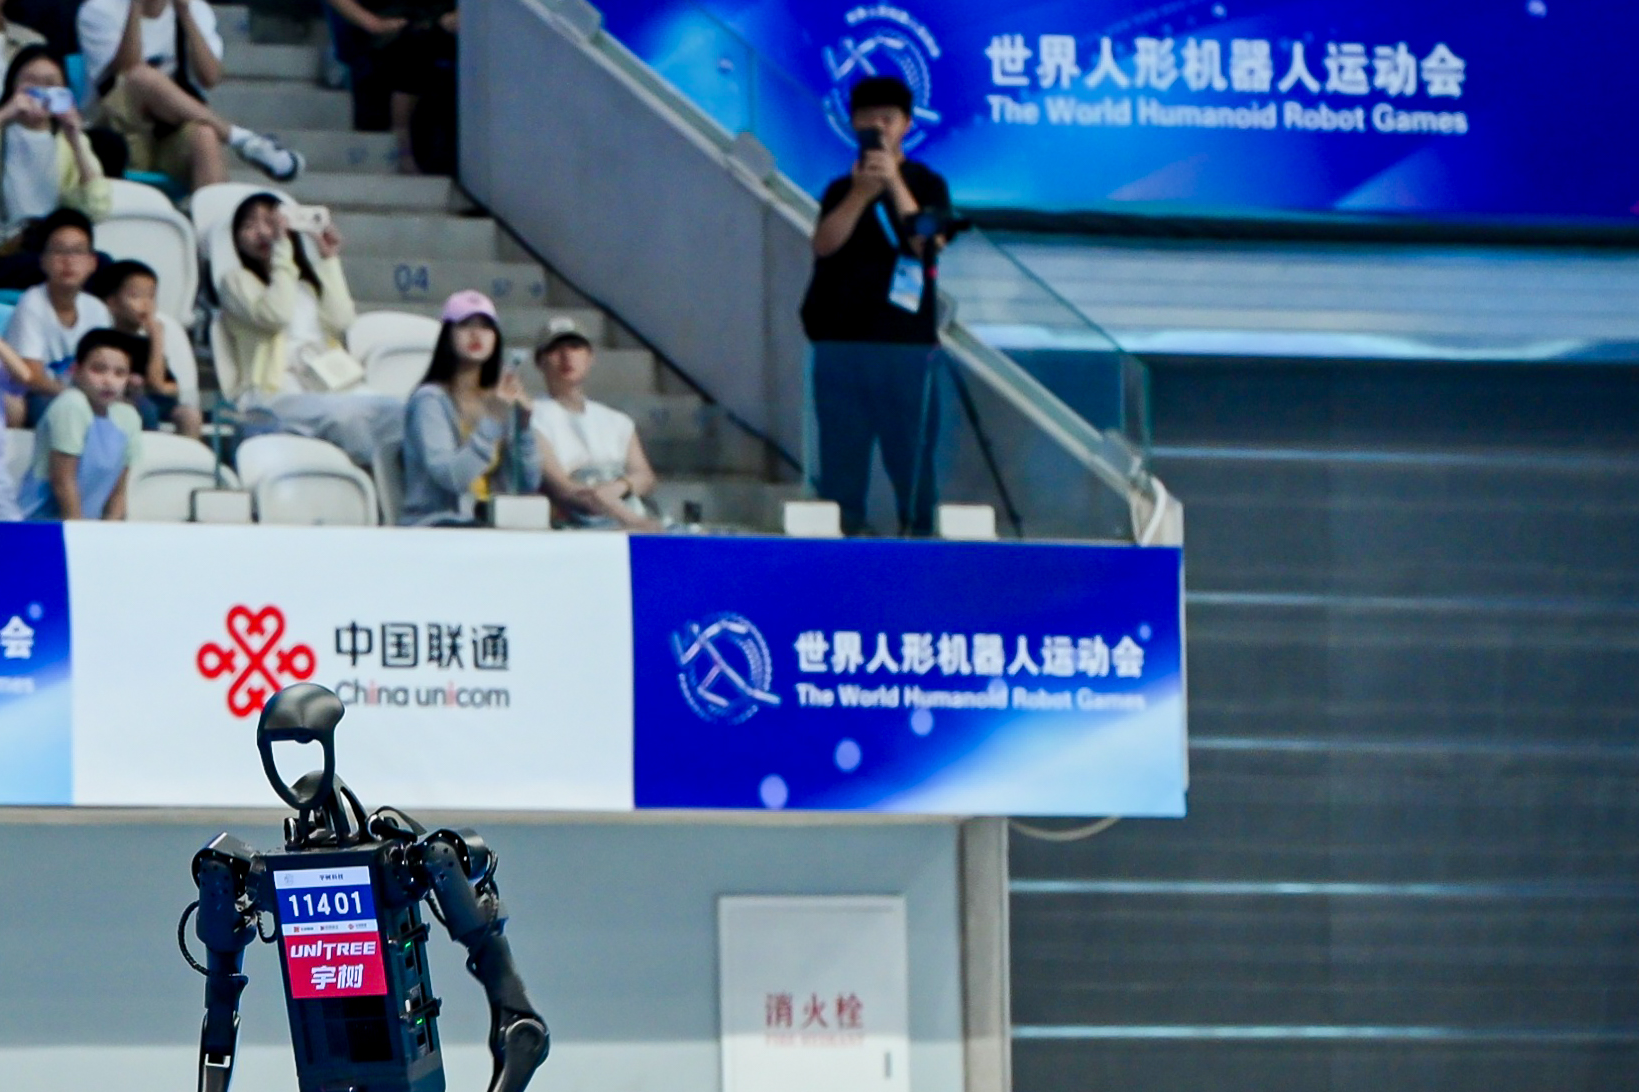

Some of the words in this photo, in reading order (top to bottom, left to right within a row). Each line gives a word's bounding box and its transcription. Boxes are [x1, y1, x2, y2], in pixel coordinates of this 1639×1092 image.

[986, 34, 1465, 97] 世界人形机器人运动会
[987, 96, 1039, 125] The
[1047, 97, 1131, 127] World
[1137, 99, 1276, 130] Humanoid
[1283, 101, 1364, 131] Robot
[1371, 103, 1467, 134] Games
[393, 264, 430, 293] 04
[334, 620, 510, 671] 中国联通
[795, 632, 1144, 678] 世界人形机器人运动会
[335, 679, 409, 708] China
[416, 681, 510, 708] unicom
[796, 683, 834, 707] The
[838, 684, 899, 708] World
[904, 685, 1008, 709] Humanoid
[1012, 687, 1073, 710] Robot
[1077, 688, 1146, 711] Games
[288, 891, 362, 917] 11401
[290, 940, 376, 960] UNITREE
[311, 963, 364, 990] 宇树
[765, 992, 863, 1030] 消火栓
